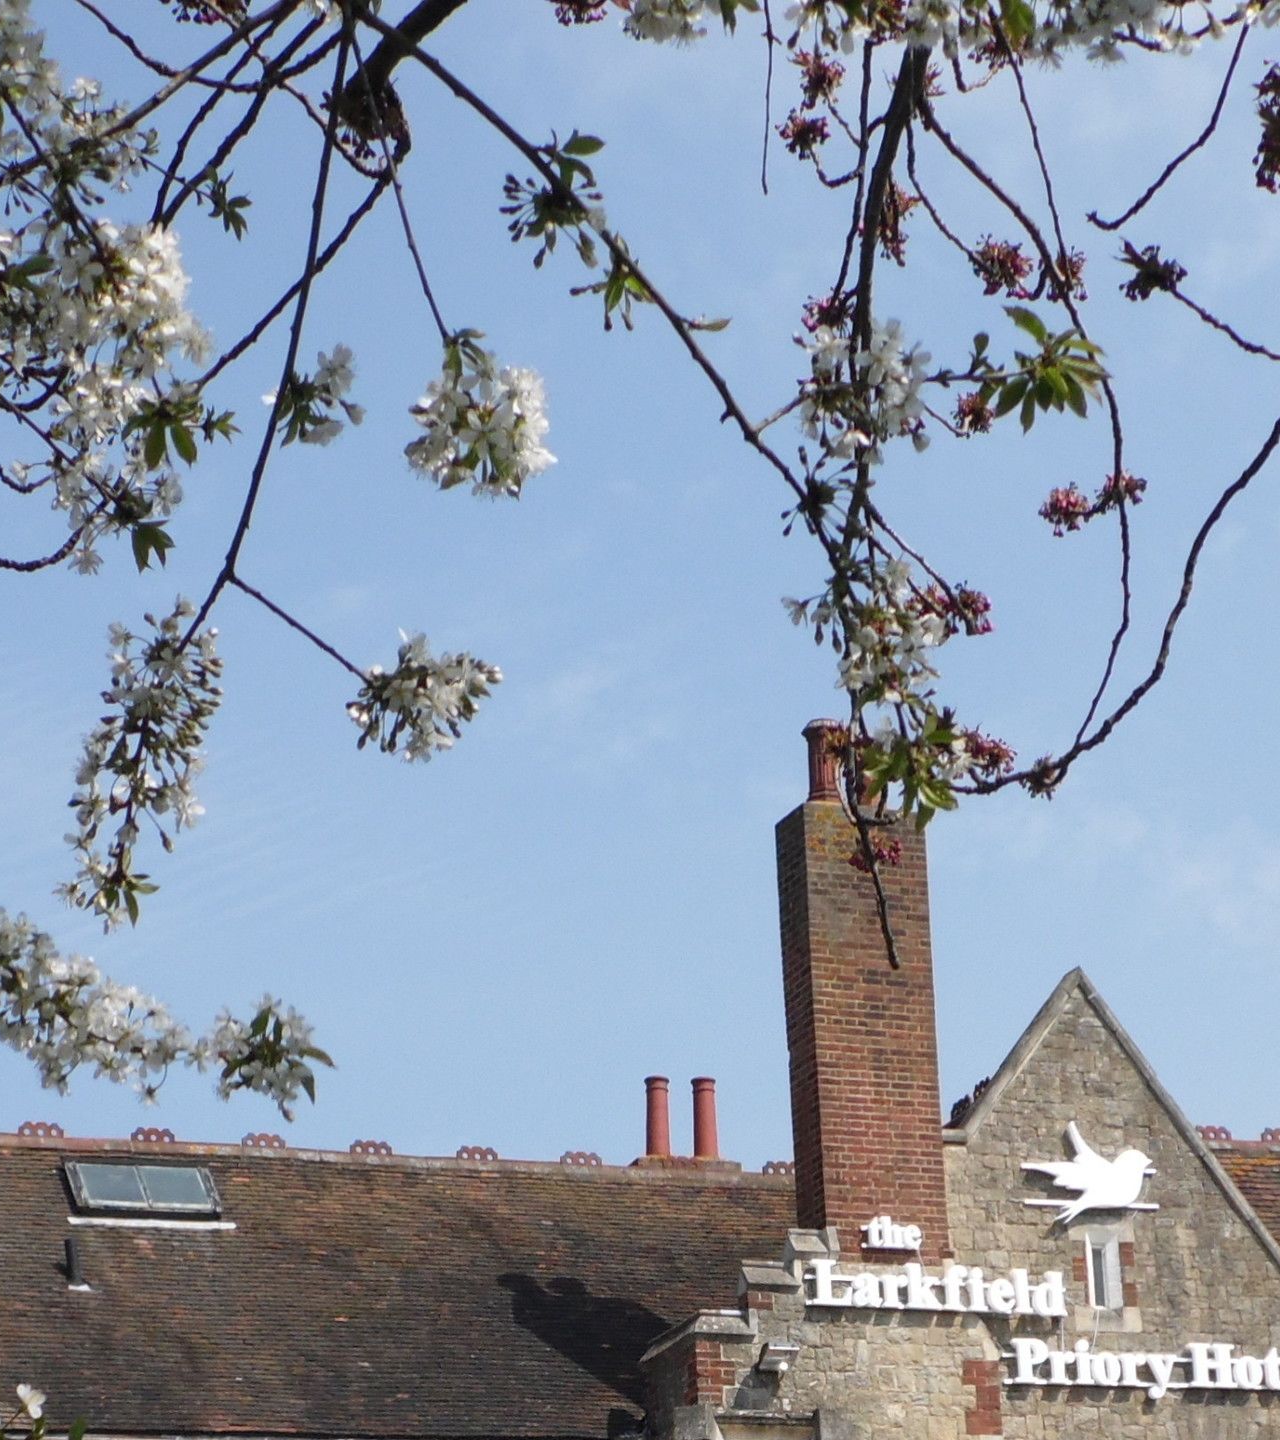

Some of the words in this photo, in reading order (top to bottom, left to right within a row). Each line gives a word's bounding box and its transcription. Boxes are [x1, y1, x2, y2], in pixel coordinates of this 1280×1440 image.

[867, 1215, 922, 1250] the
[810, 1258, 1069, 1317] Larkfield
[1009, 1337, 1177, 1399] Priory
